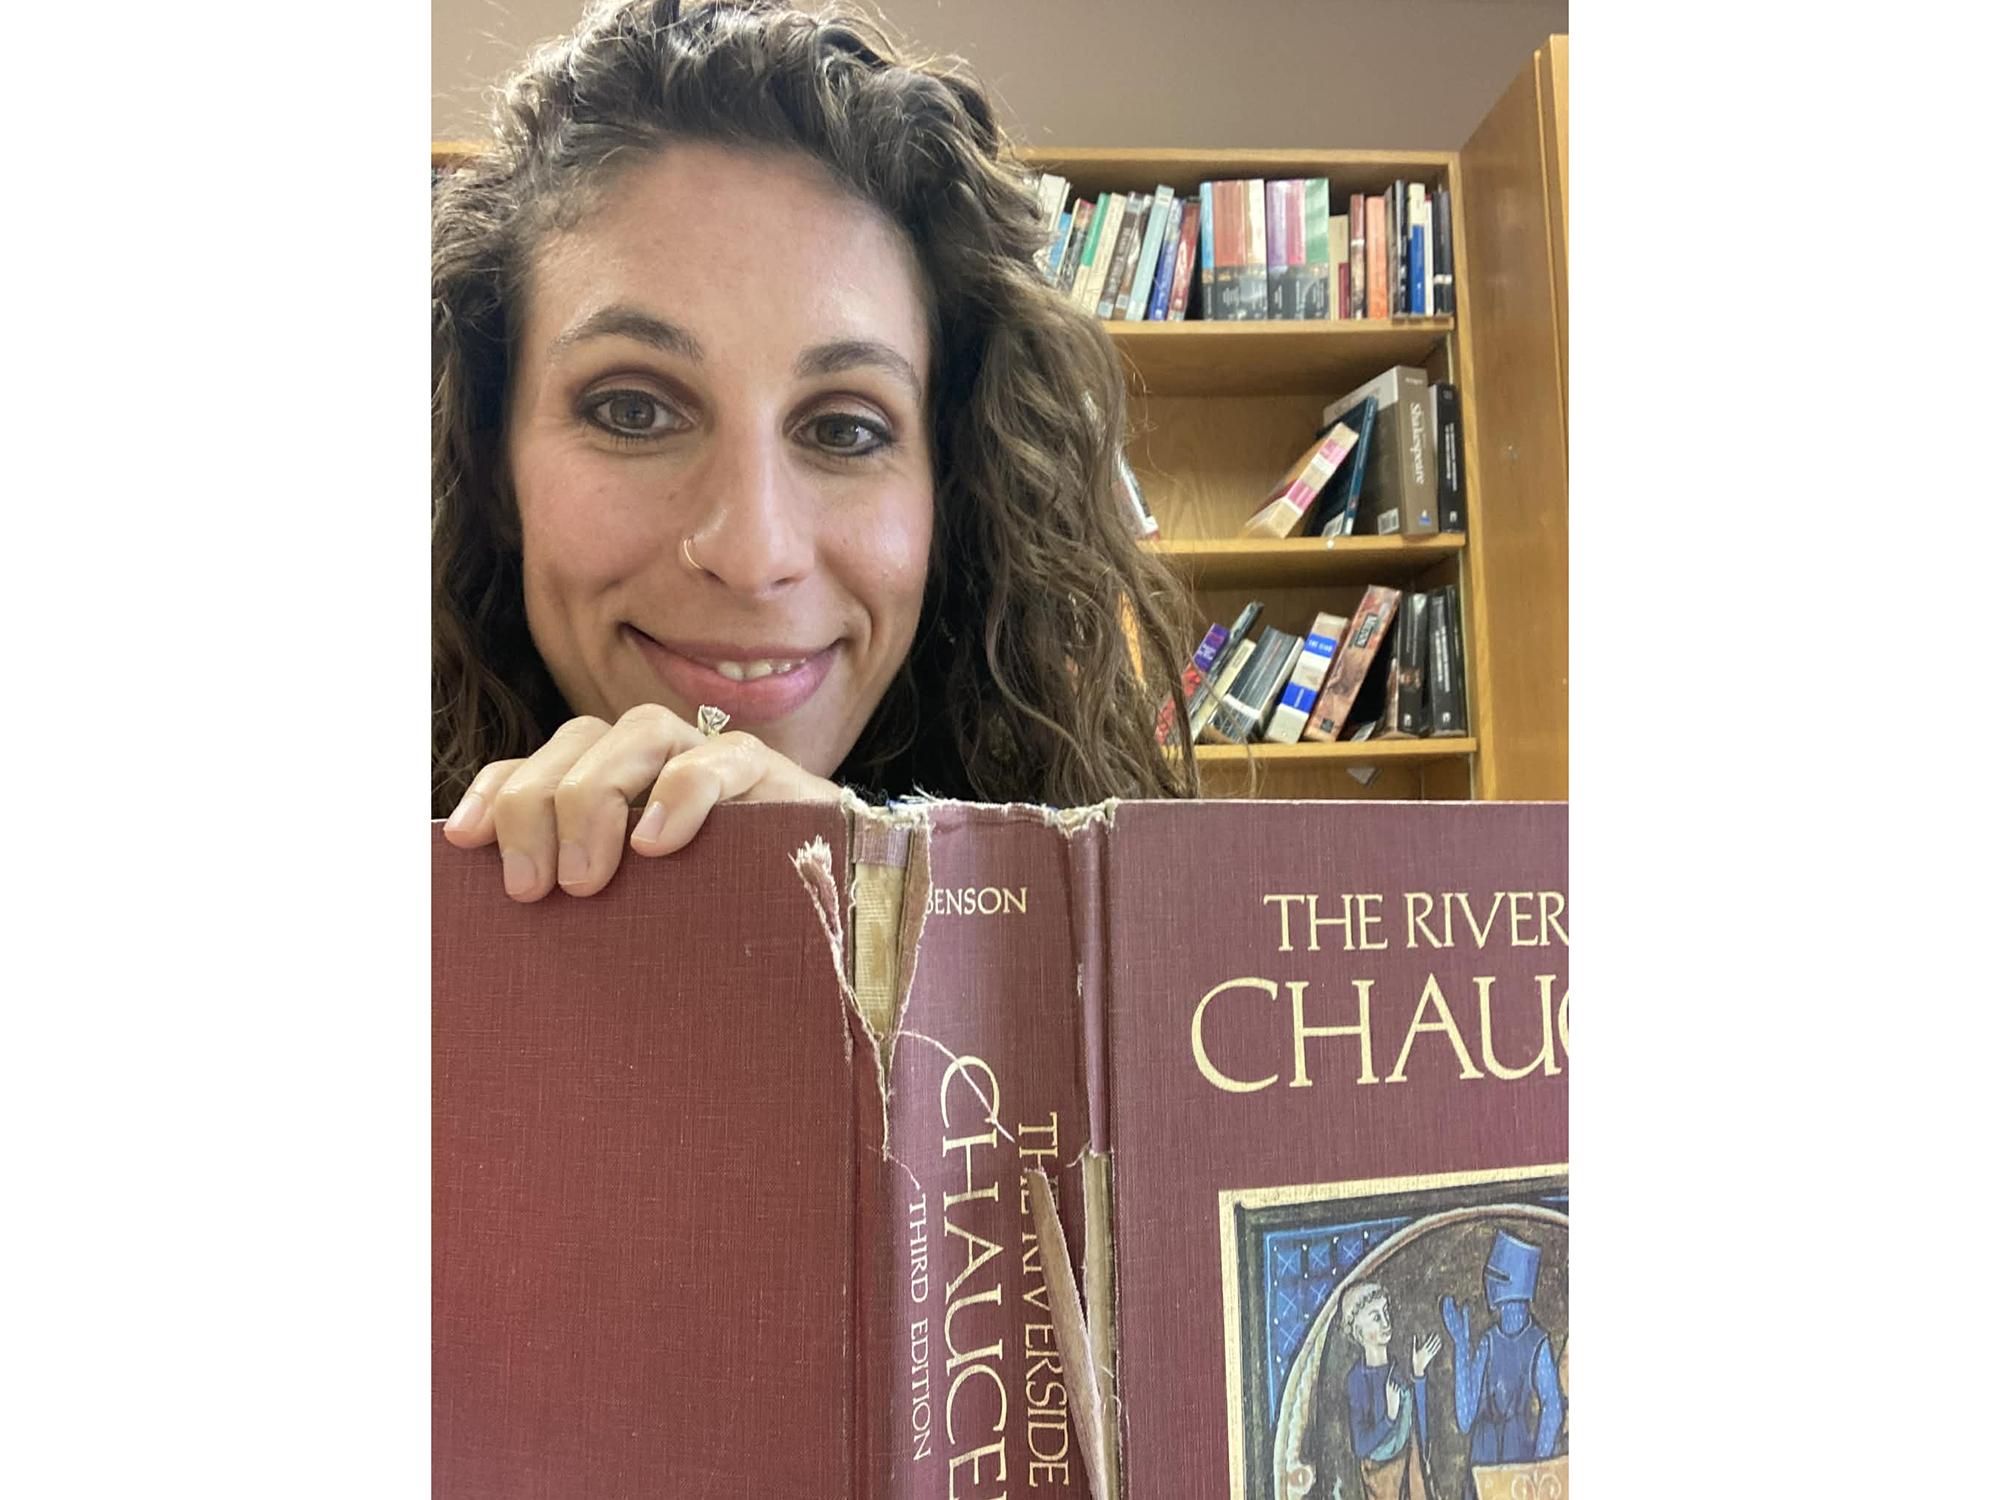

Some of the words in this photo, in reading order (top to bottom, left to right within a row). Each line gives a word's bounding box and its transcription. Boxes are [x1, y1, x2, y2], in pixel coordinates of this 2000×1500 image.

[1263, 893, 1388, 951] THE
[1191, 972, 1569, 1093] CHAU
[909, 1193, 929, 1304] THIRD
[941, 1055, 1008, 1500] CHAUCE
[911, 1317, 932, 1461] EDITION
